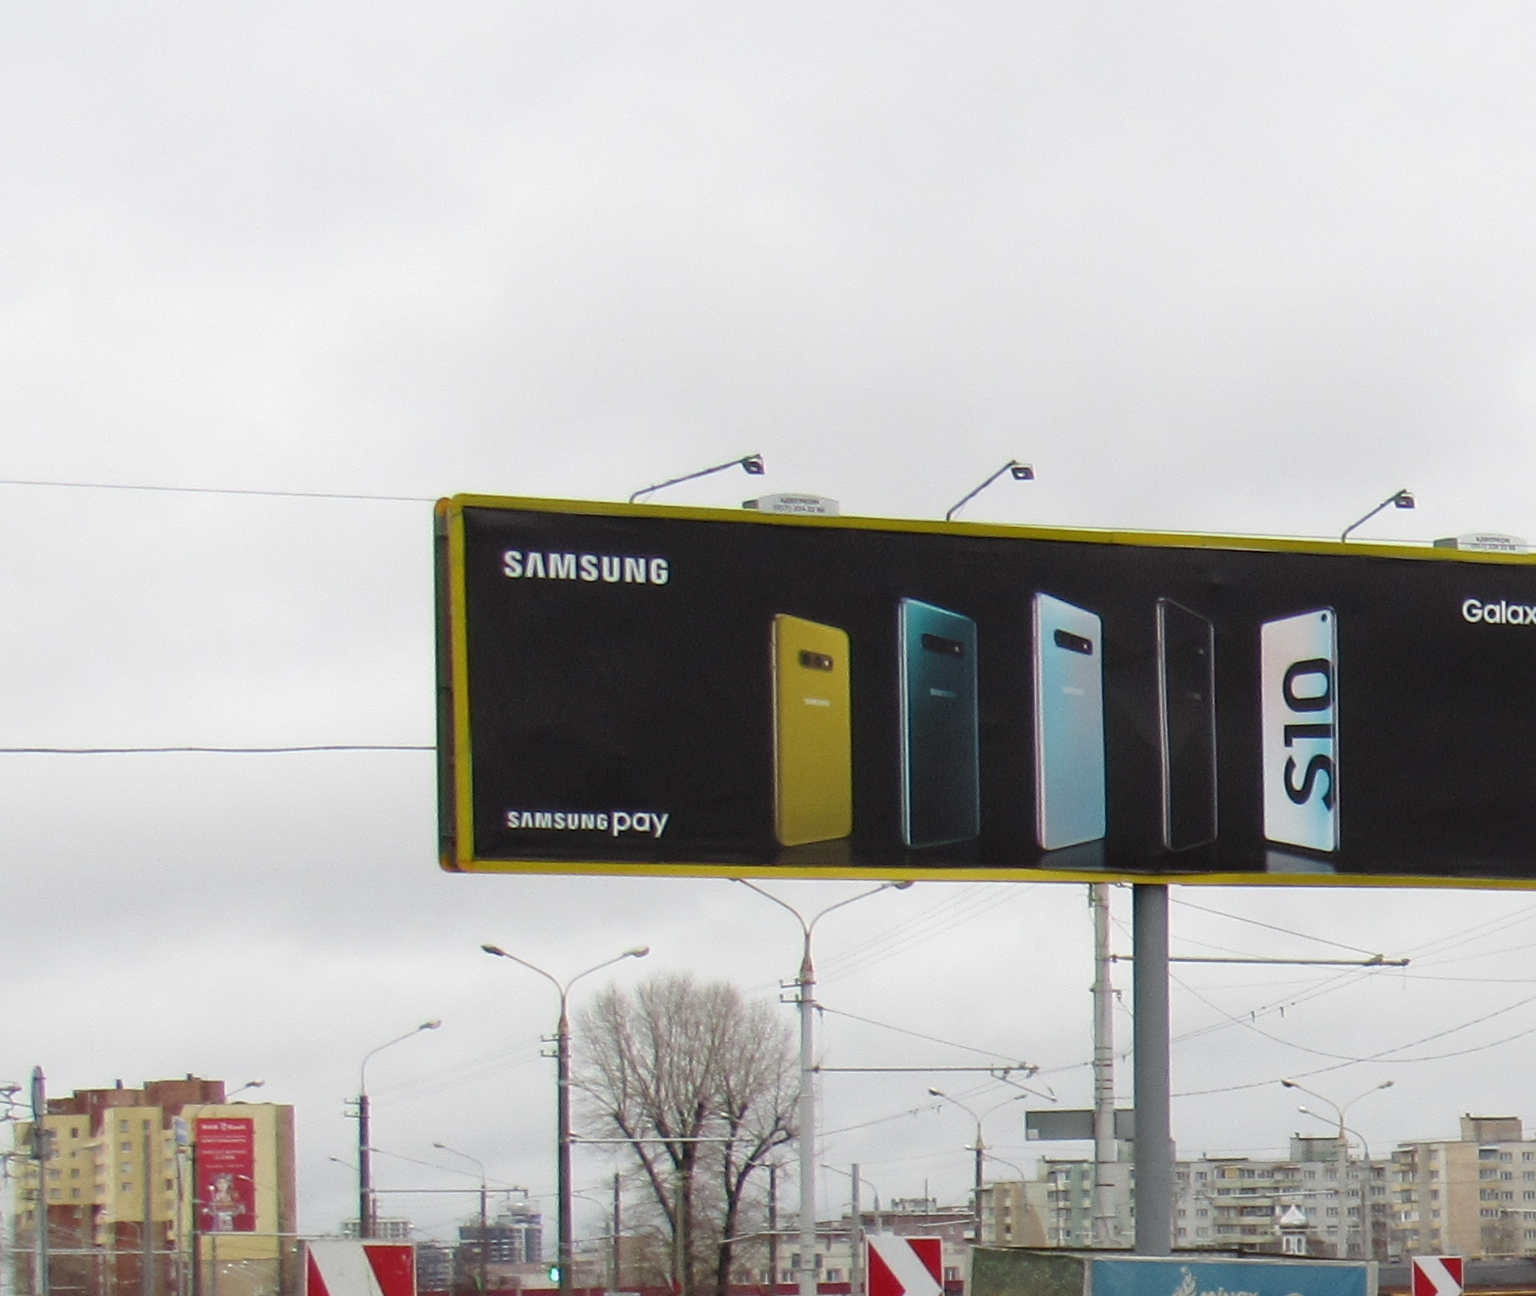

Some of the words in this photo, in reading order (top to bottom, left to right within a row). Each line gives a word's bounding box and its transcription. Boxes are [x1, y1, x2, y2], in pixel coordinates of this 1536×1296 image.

[503, 550, 669, 585] SAMSUNG
[1283, 657, 1336, 812] S10
[507, 811, 608, 831] SAMSUNG
[612, 811, 669, 838] pay
